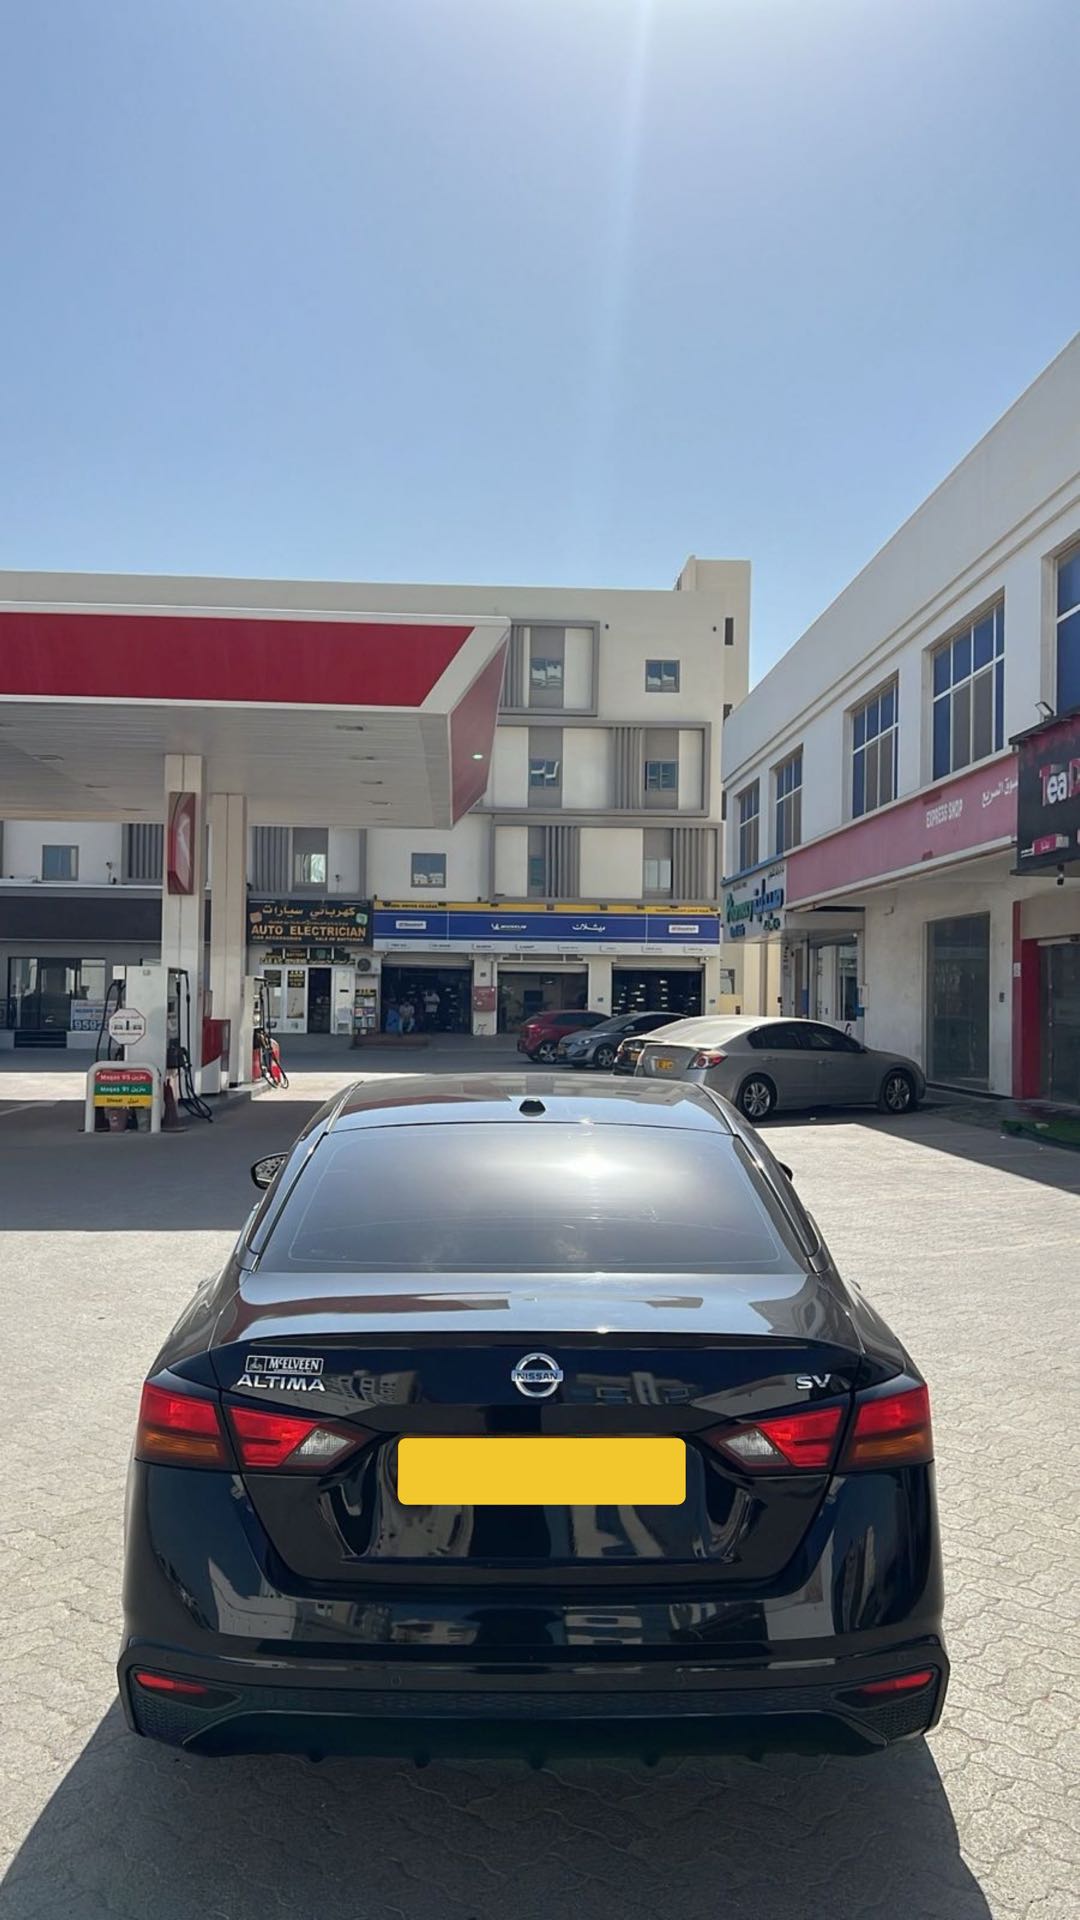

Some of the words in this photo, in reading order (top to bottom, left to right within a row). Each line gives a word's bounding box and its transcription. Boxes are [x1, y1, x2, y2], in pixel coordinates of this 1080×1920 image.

[926, 802, 948, 828] EXPRESS
[948, 799, 963, 819] SHOP
[262, 904, 304, 918] سيارات
[251, 925, 283, 935] AUTO
[290, 925, 366, 937] ELECTRICIAN
[236, 1374, 326, 1392] ALTIMA
[516, 1372, 558, 1380] NISSAN
[796, 1373, 832, 1390] SV
